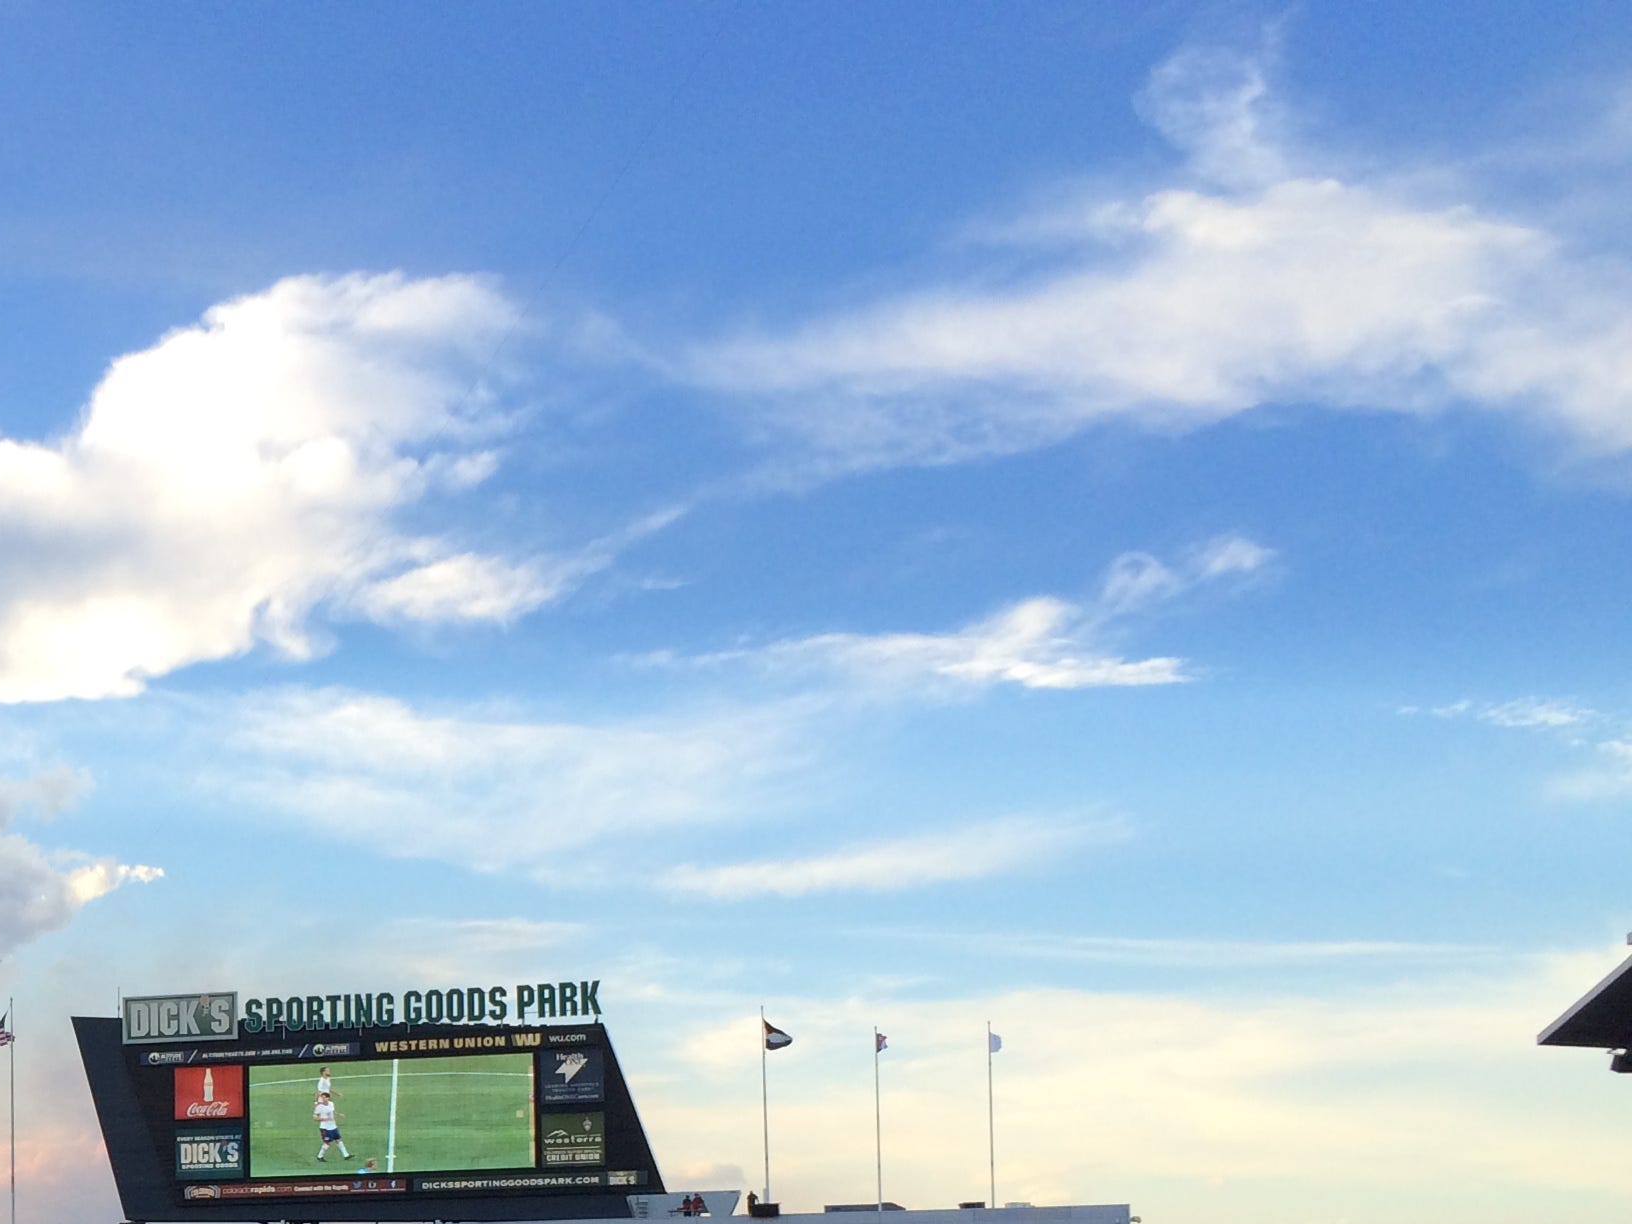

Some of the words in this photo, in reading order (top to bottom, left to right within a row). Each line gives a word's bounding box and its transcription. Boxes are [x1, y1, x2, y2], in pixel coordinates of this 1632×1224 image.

[244, 993, 394, 1032] SPORTING
[403, 986, 507, 1025] GOODS
[516, 980, 602, 1019] PARK
[375, 1038, 450, 1052] WESTERN
[453, 1035, 506, 1049] UNION
[548, 1033, 586, 1043] wu.com
[421, 1176, 599, 1189] DICKSSPORTINGGOODSPARK.COM
